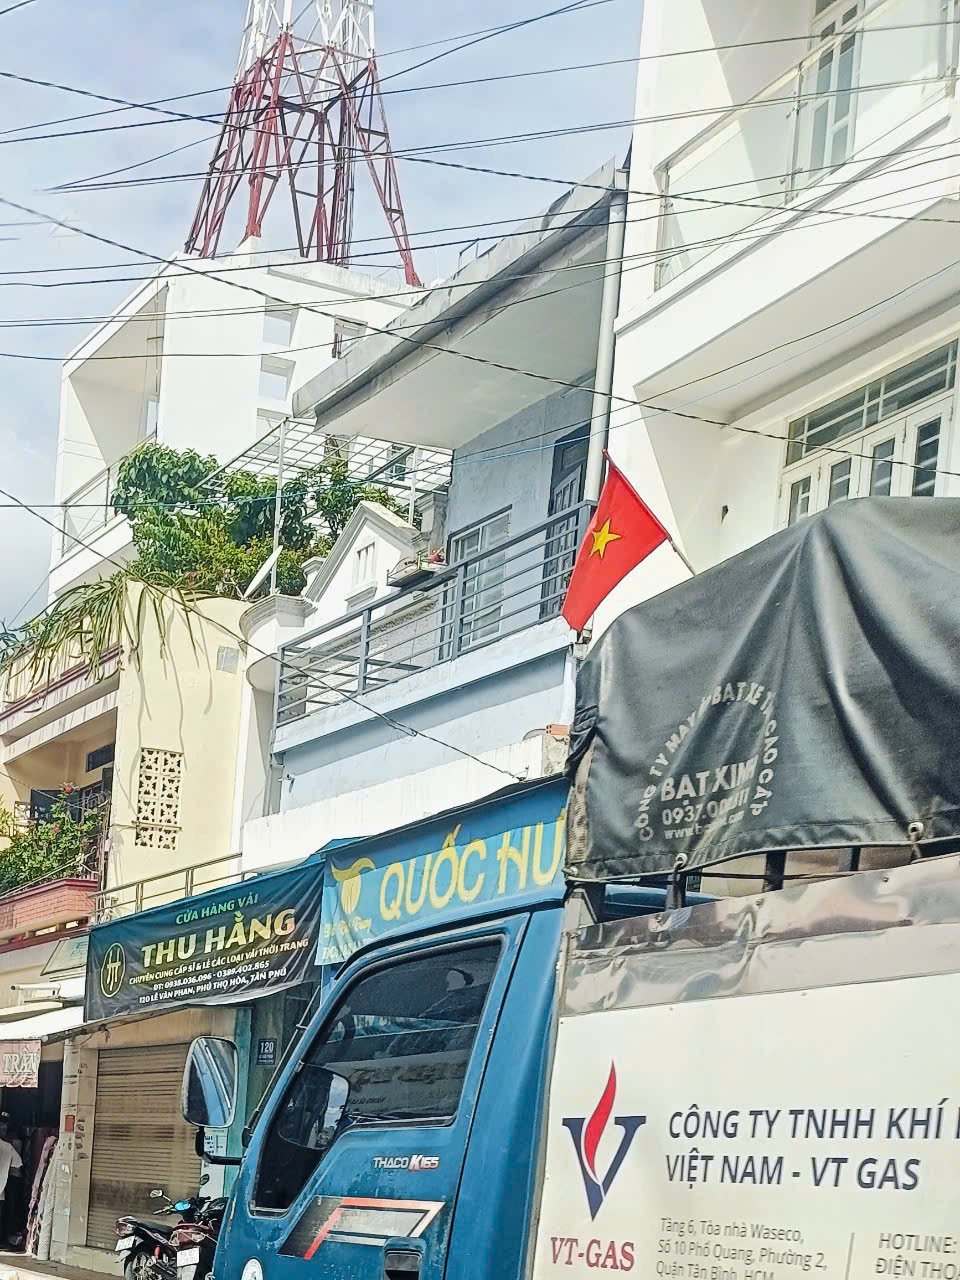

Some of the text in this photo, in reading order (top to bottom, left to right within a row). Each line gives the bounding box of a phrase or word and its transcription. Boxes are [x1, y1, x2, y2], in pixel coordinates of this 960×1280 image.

[661, 770, 710, 806] BẠT
[380, 808, 567, 920] QUỐC HƯ
[175, 892, 259, 925] CỬA HÀNG VẢI
[140, 933, 197, 968] THU
[204, 909, 297, 952] HẰNG
[129, 971, 156, 985] CHUYÊN
[155, 968, 174, 981] CUNG
[279, 939, 309, 952] TRANG
[260, 1042, 274, 1053] 120
[669, 1103, 740, 1139] CÔNG
[749, 1109, 781, 1139] TY
[789, 1108, 876, 1139] TNHH
[885, 1097, 950, 1139] KHÍ
[373, 1156, 408, 1169] THACO
[666, 1147, 714, 1190] VIỆT
[720, 1155, 784, 1185] NAM
[811, 1156, 848, 1187] VT
[857, 1157, 921, 1190] GAS
[660, 1216, 686, 1238] Tầng
[700, 1220, 721, 1236] Tòa
[724, 1221, 747, 1238] nhà
[751, 1223, 805, 1245] Waseco,
[879, 1232, 957, 1254] HOTLINE:
[550, 1236, 635, 1272] VT-GAS
[656, 1260, 685, 1279] Quận
[687, 1263, 708, 1280] Tân
[657, 1239, 671, 1254] Số
[675, 1241, 686, 1255] 10
[688, 1240, 711, 1257] Phố
[759, 1247, 812, 1271] Phường
[815, 1252, 828, 1271] 2,
[875, 1254, 960, 1280] ĐIỆN THO
